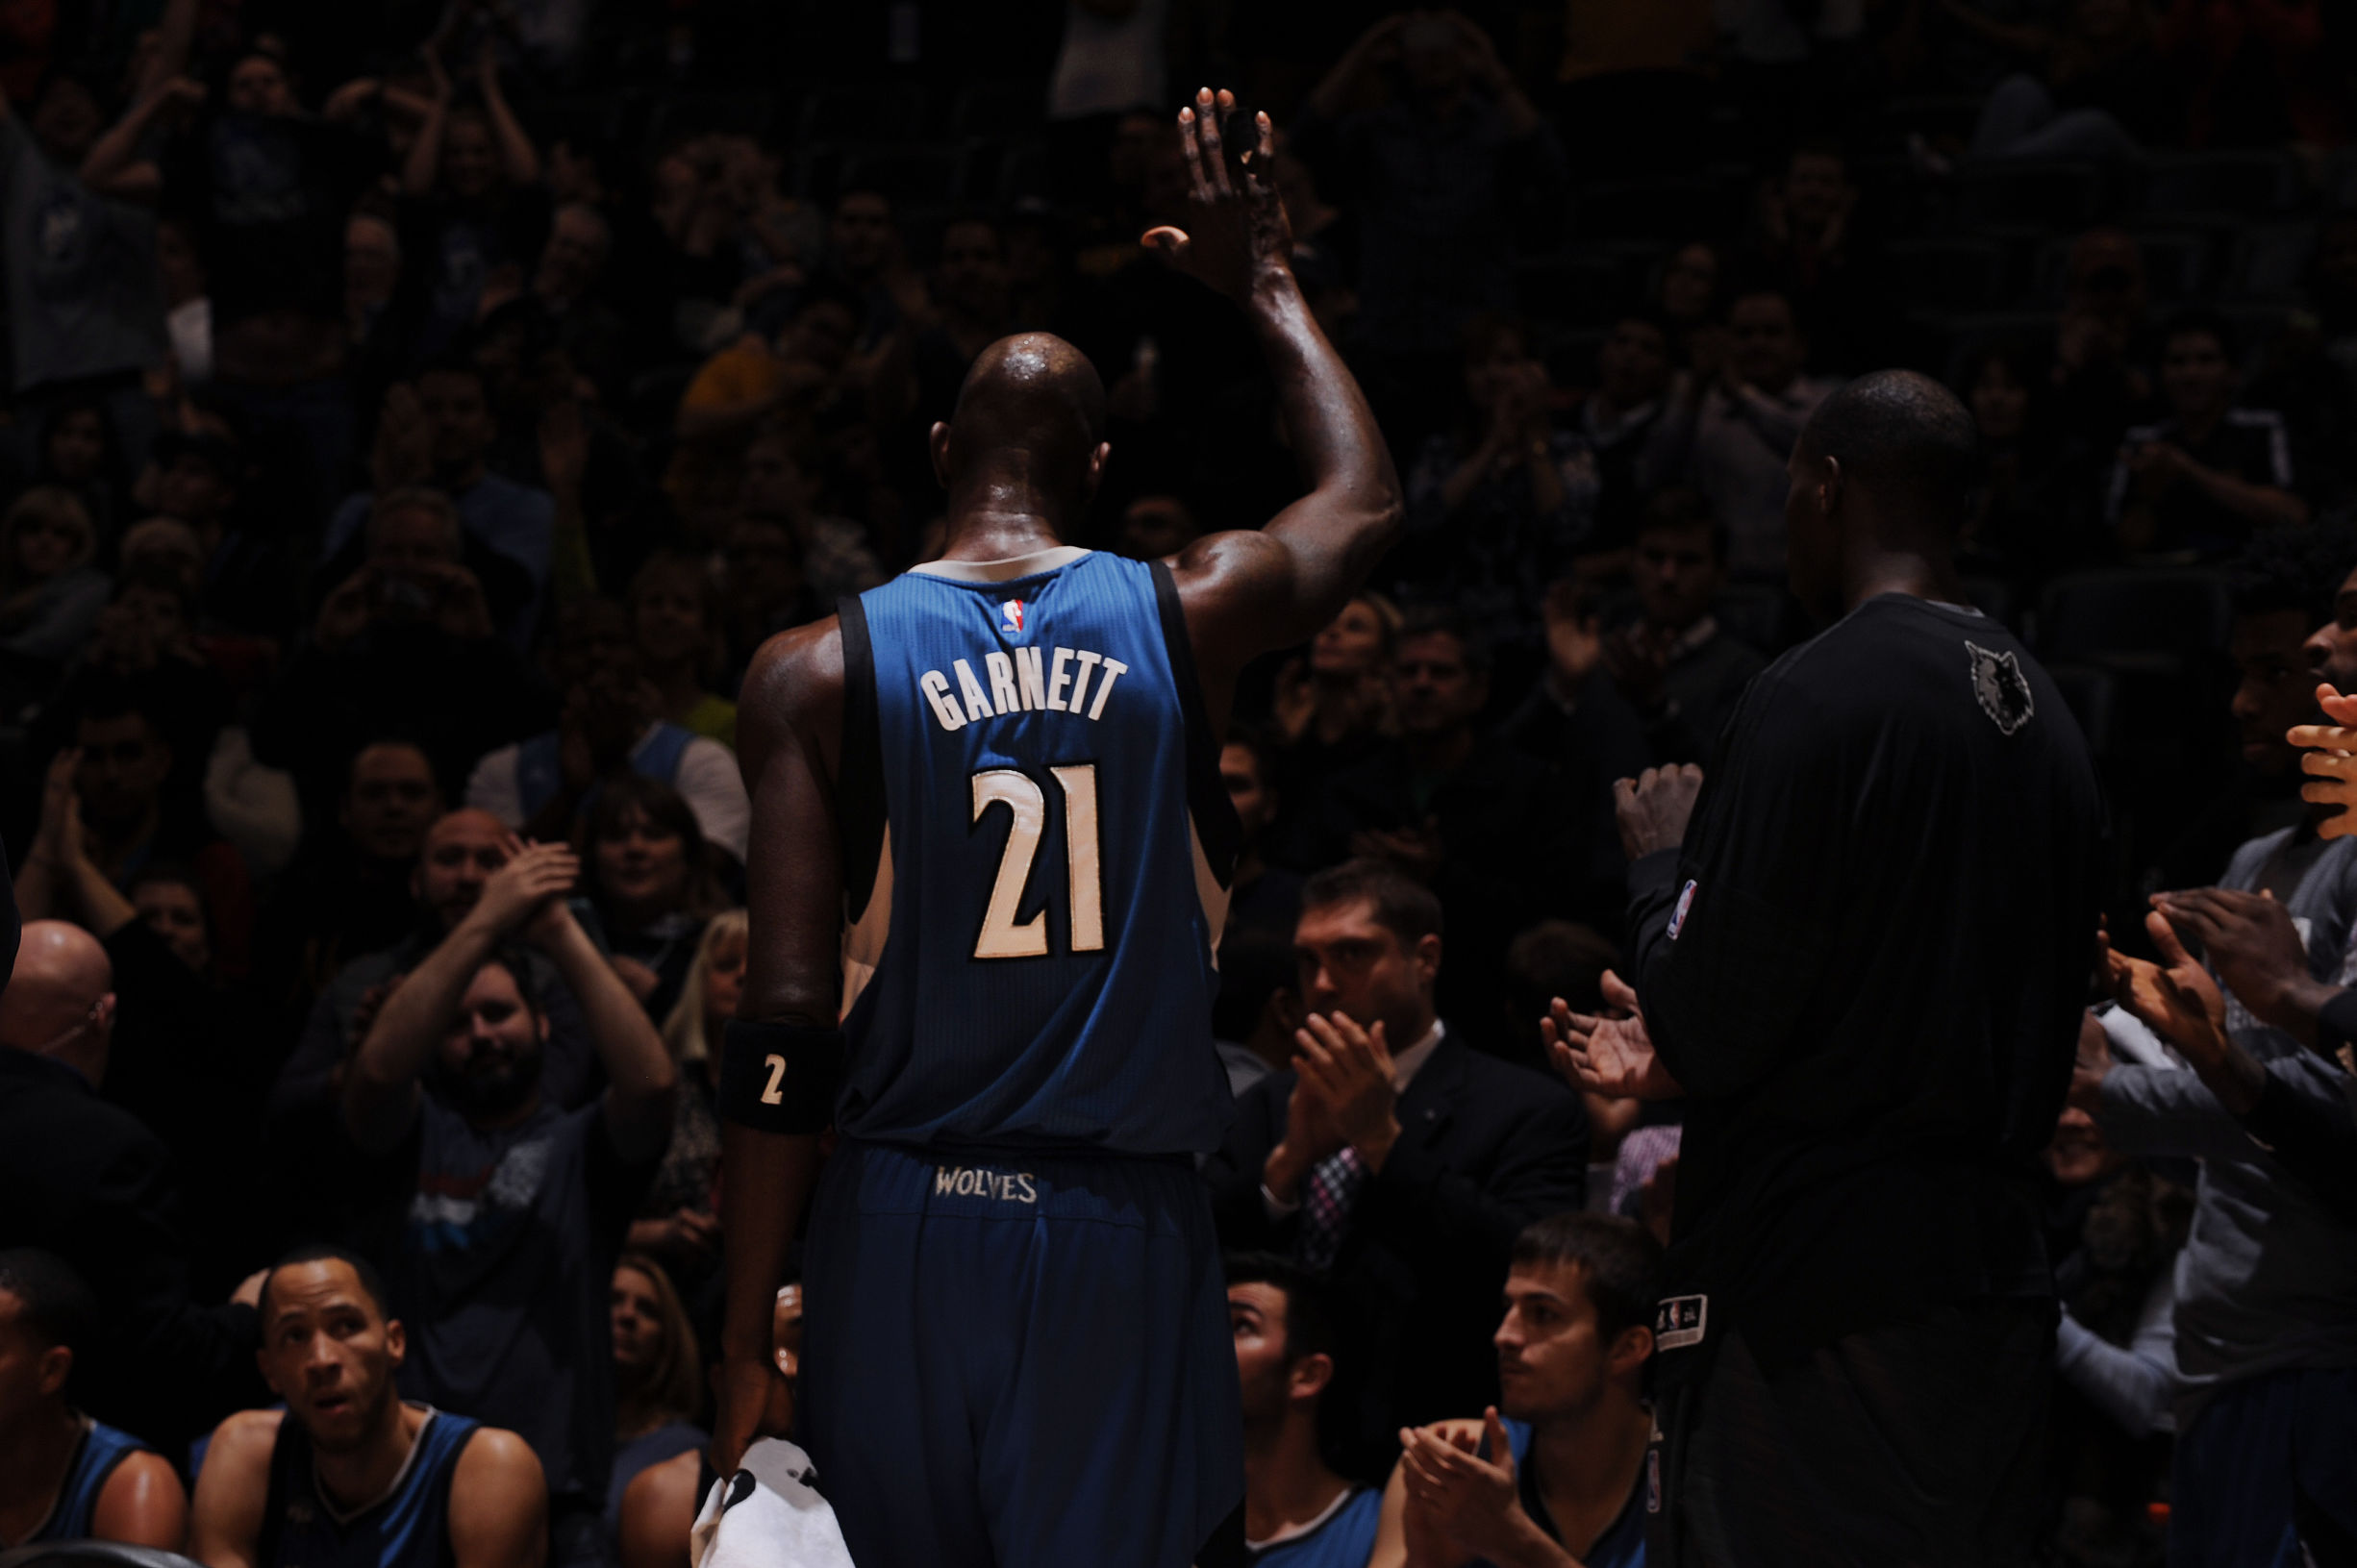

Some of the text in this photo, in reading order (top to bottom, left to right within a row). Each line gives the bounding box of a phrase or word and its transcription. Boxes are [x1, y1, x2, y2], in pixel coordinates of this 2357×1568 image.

[920, 646, 1129, 731] GARNETT
[970, 762, 1107, 960] 21
[760, 1053, 787, 1106] 2
[935, 1165, 1038, 1204] WOLVES
